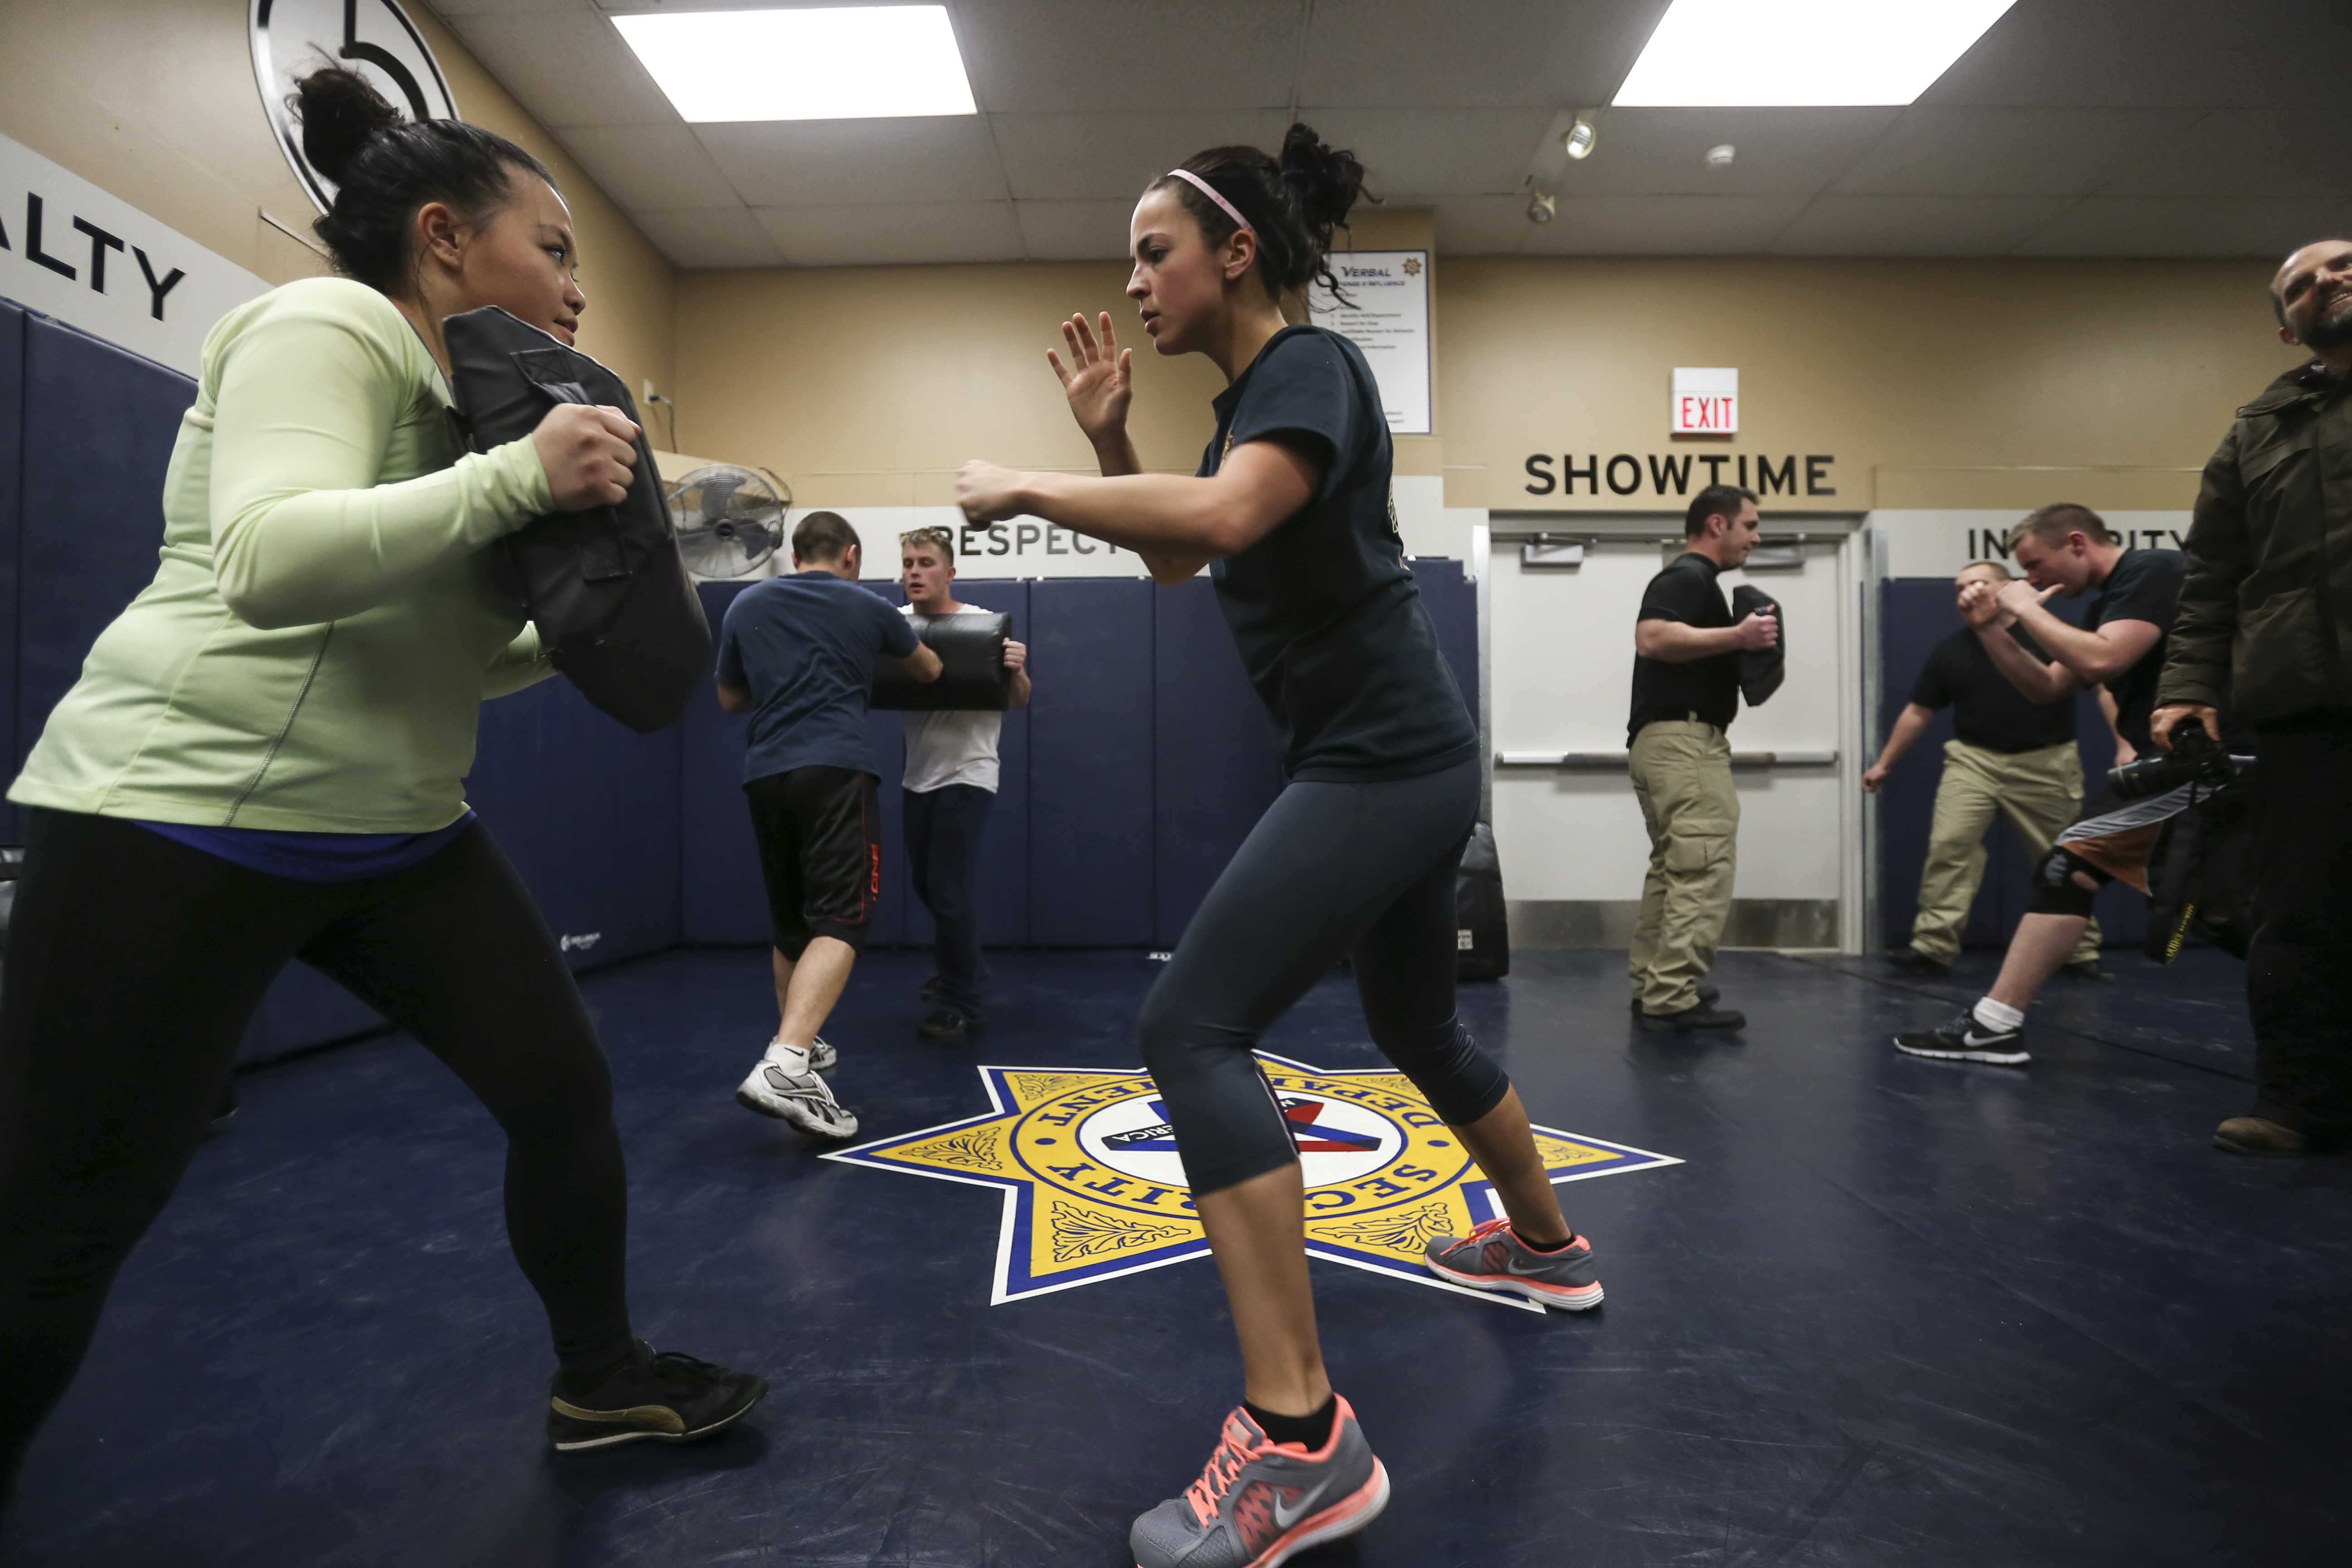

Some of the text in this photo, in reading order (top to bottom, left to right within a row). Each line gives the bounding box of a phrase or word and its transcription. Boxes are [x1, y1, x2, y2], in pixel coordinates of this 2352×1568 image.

[0, 191, 187, 322] LTY
[1683, 397, 1733, 428] EXIT
[1525, 453, 1837, 495] SHOWTIME
